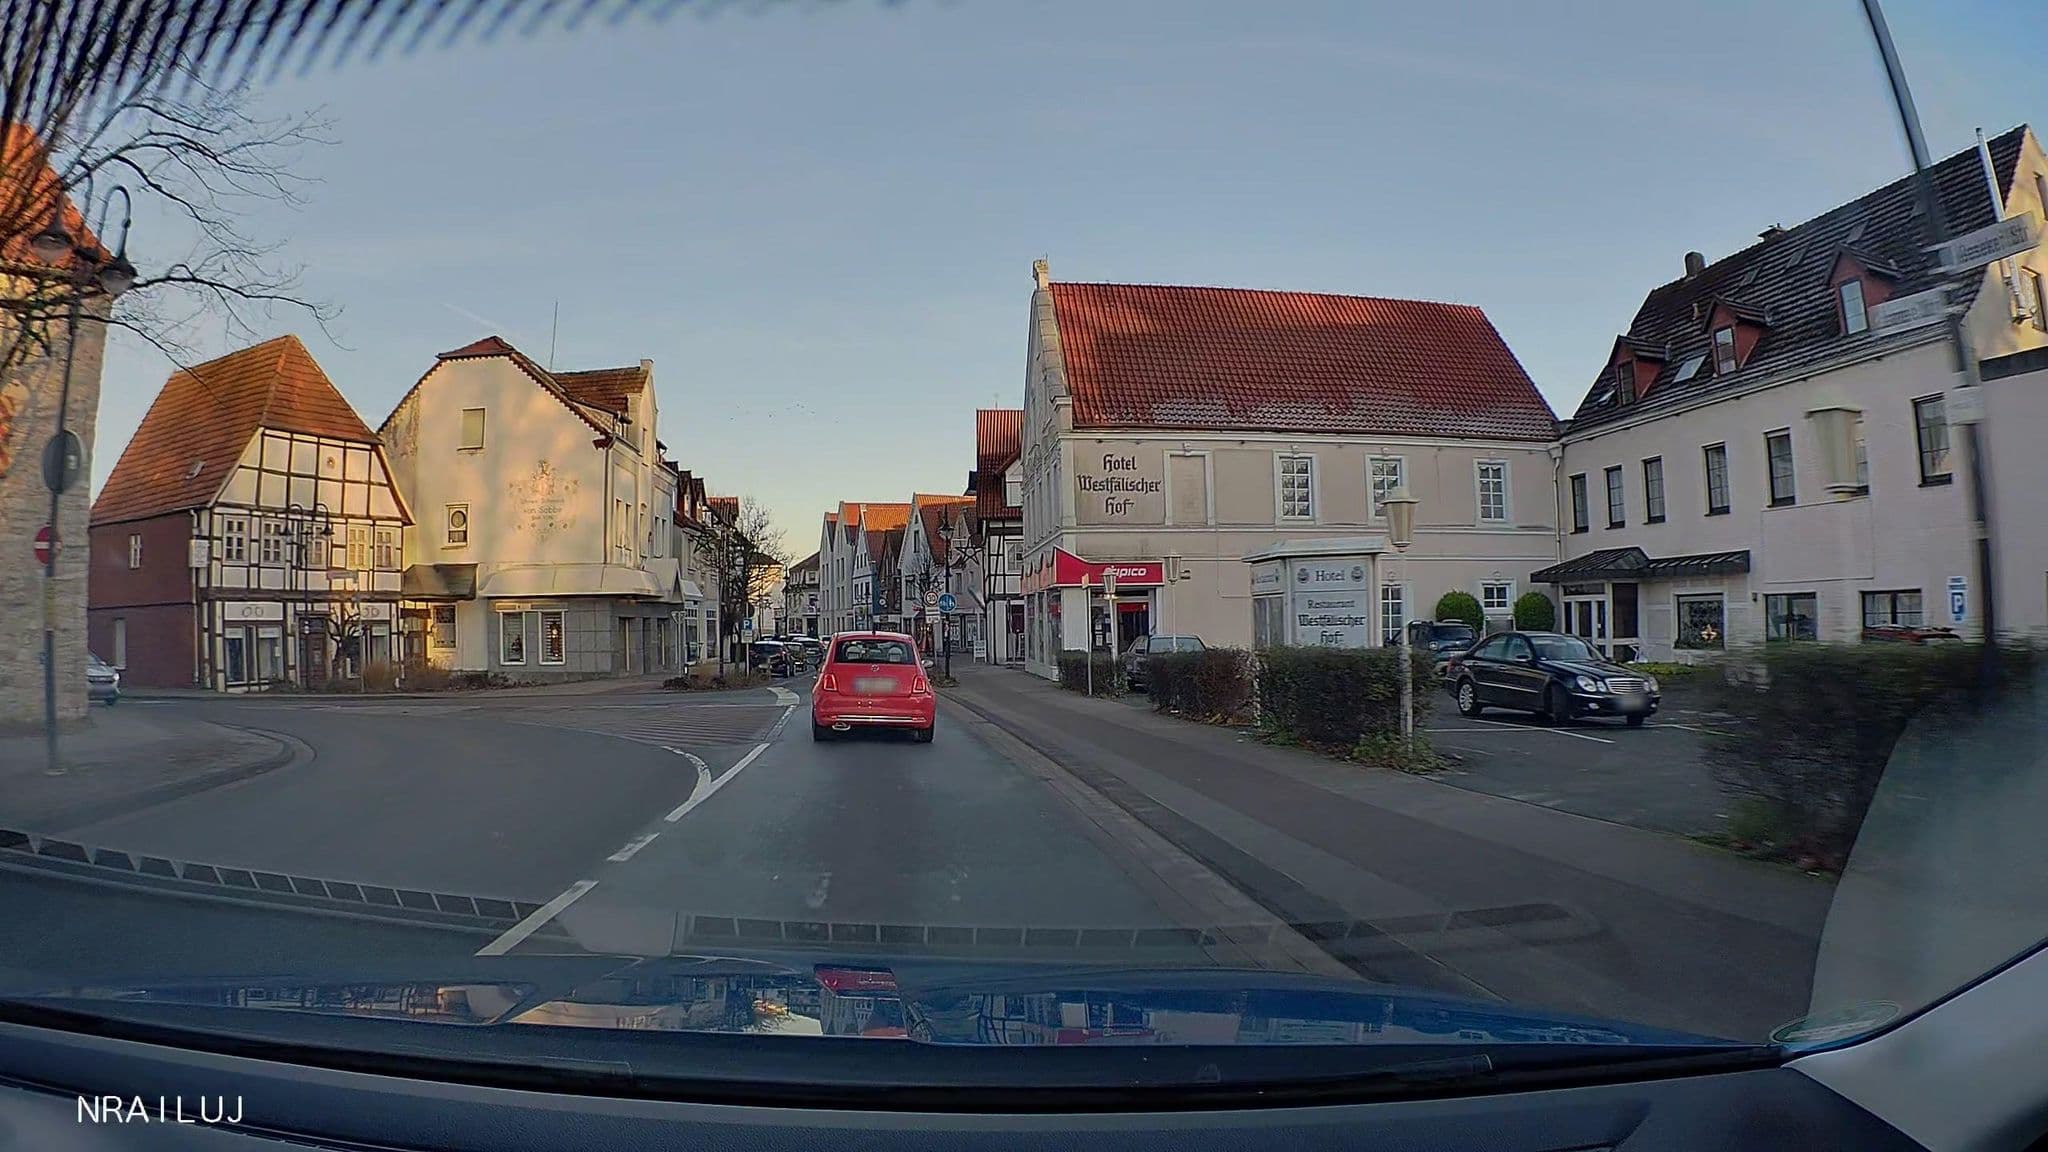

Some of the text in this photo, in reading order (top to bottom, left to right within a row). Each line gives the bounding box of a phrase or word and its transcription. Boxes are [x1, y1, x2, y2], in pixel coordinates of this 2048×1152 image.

[1103, 454, 1137, 472] Hotel
[1077, 475, 1161, 494] Westfälischer
[1105, 496, 1134, 515] Hof
[1315, 569, 1345, 581] Hotel
[1954, 594, 1963, 612] P
